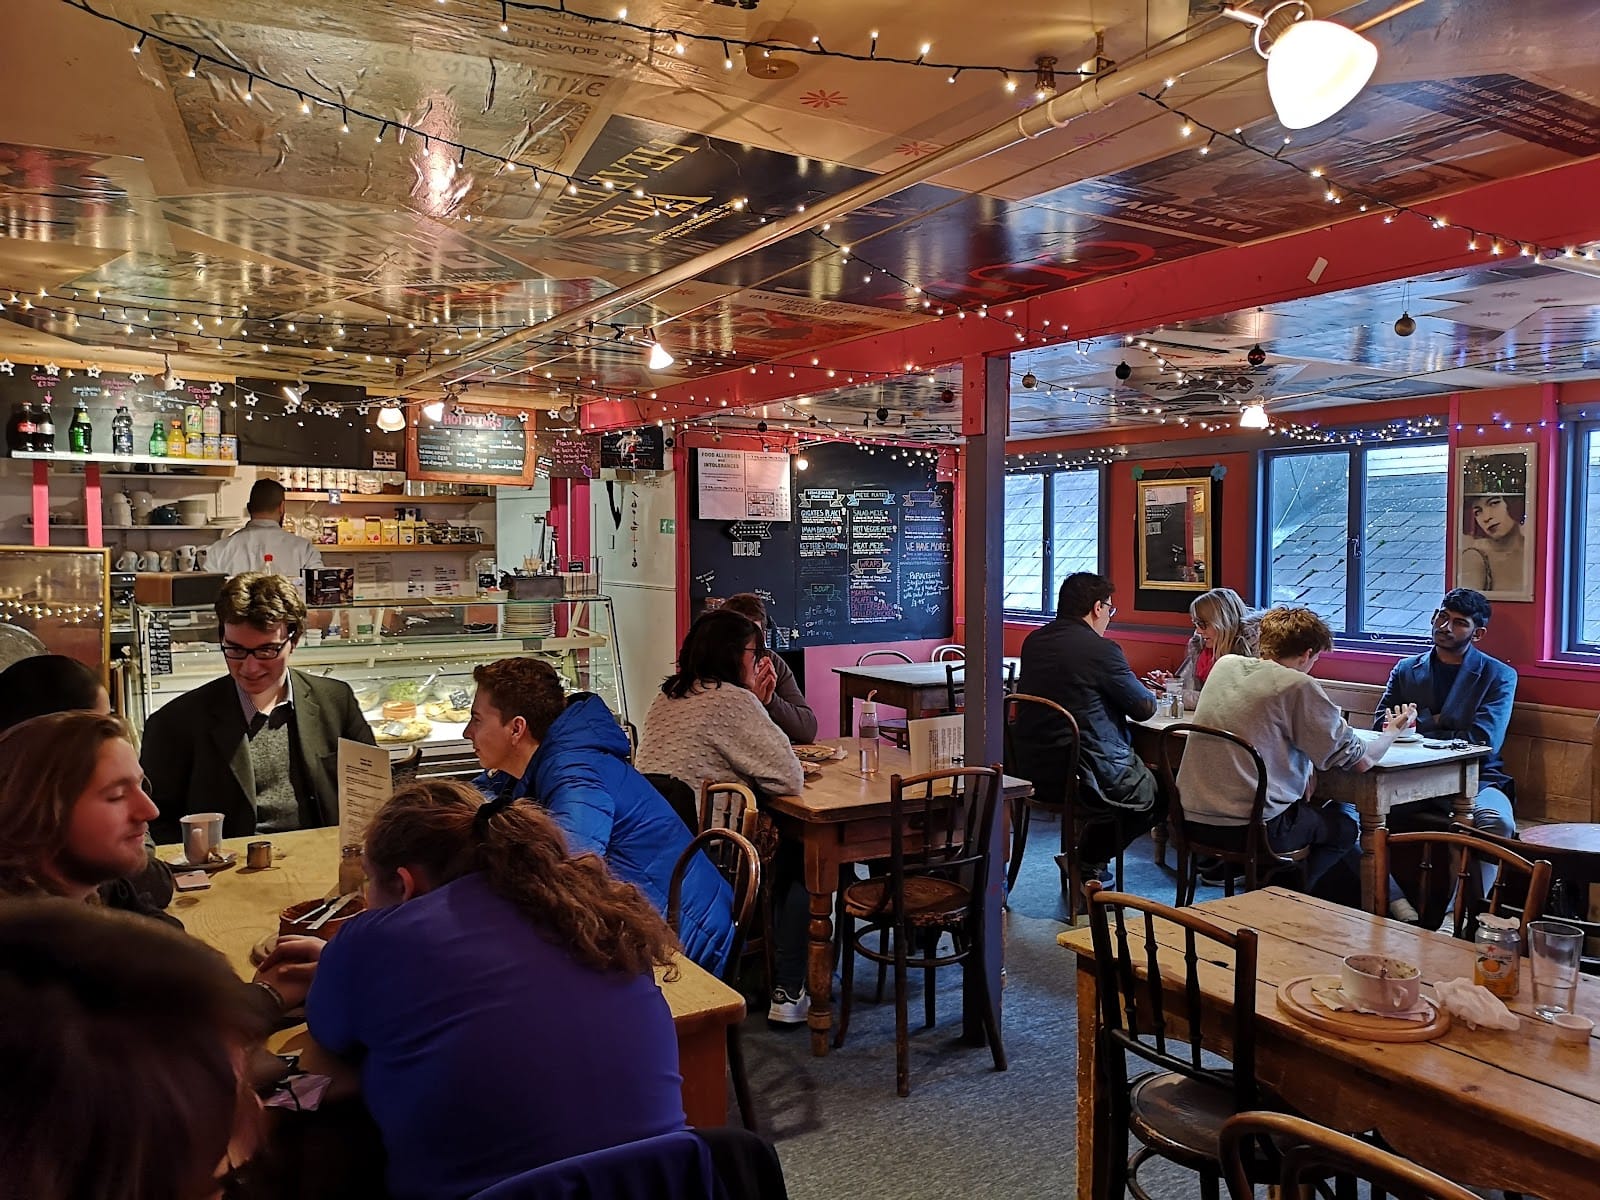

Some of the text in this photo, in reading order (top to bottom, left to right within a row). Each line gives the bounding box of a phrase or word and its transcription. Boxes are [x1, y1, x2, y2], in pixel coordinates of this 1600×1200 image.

[588, 193, 714, 232] WILD
[1081, 192, 1197, 220] DRIVER
[1194, 215, 1263, 234] TAXI
[443, 414, 502, 428] HOT DRINKS
[732, 541, 762, 557] HERE
[904, 542, 915, 551] WE
[915, 542, 929, 551] HAVE
[860, 560, 881, 568] WRAPS
